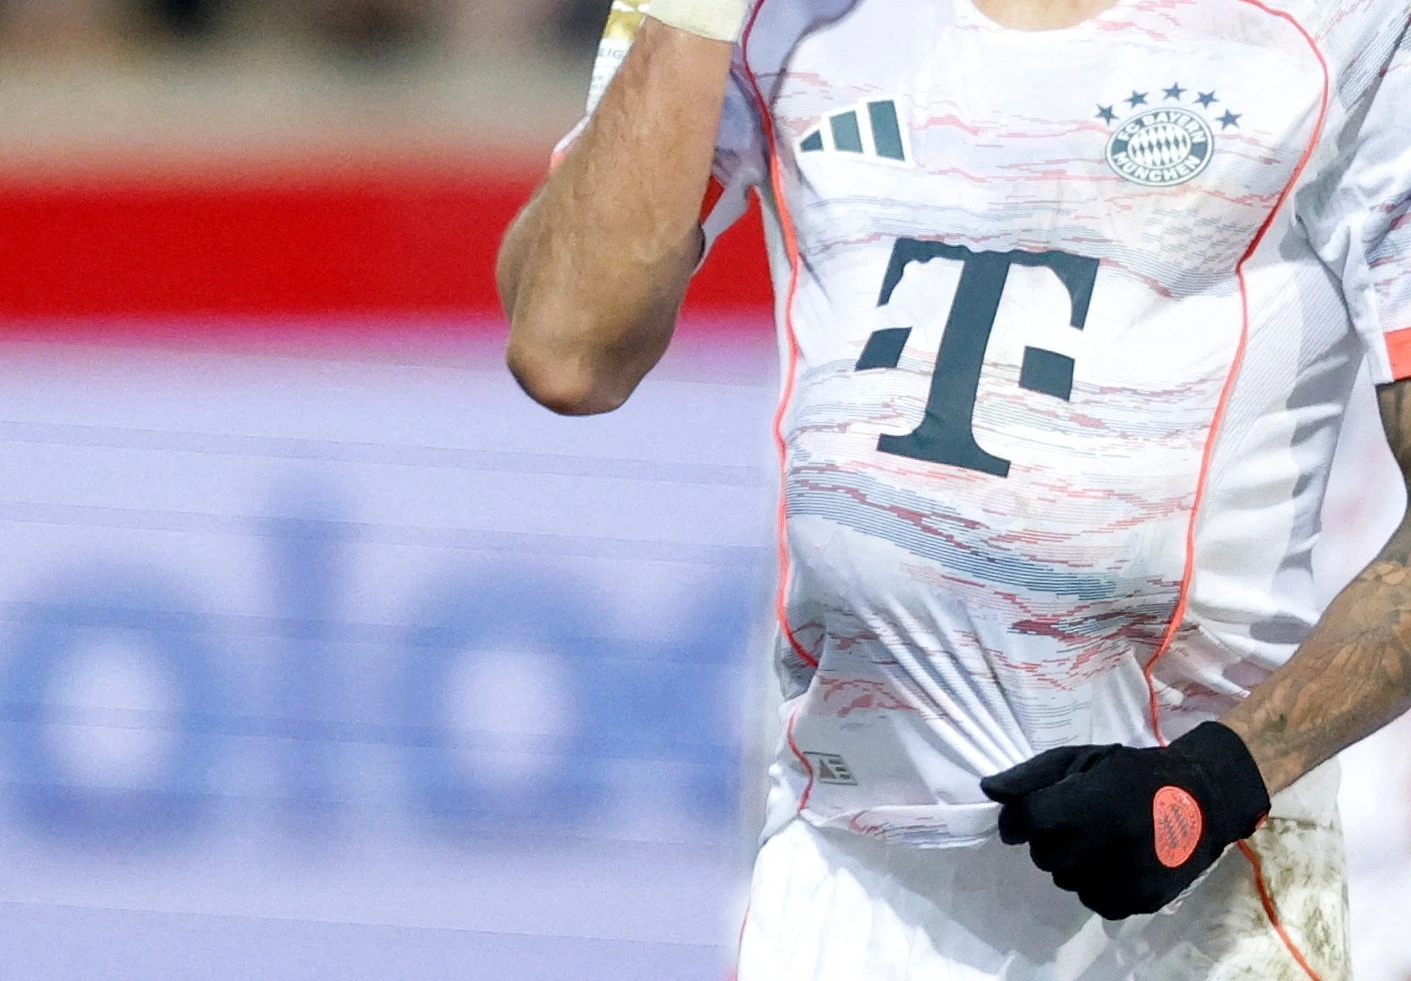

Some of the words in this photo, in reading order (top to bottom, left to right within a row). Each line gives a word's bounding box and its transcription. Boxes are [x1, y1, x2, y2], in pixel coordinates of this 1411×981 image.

[1117, 122, 1141, 142] FC
[1141, 111, 1206, 143] BAYERN
[855, 237, 1100, 479] T
